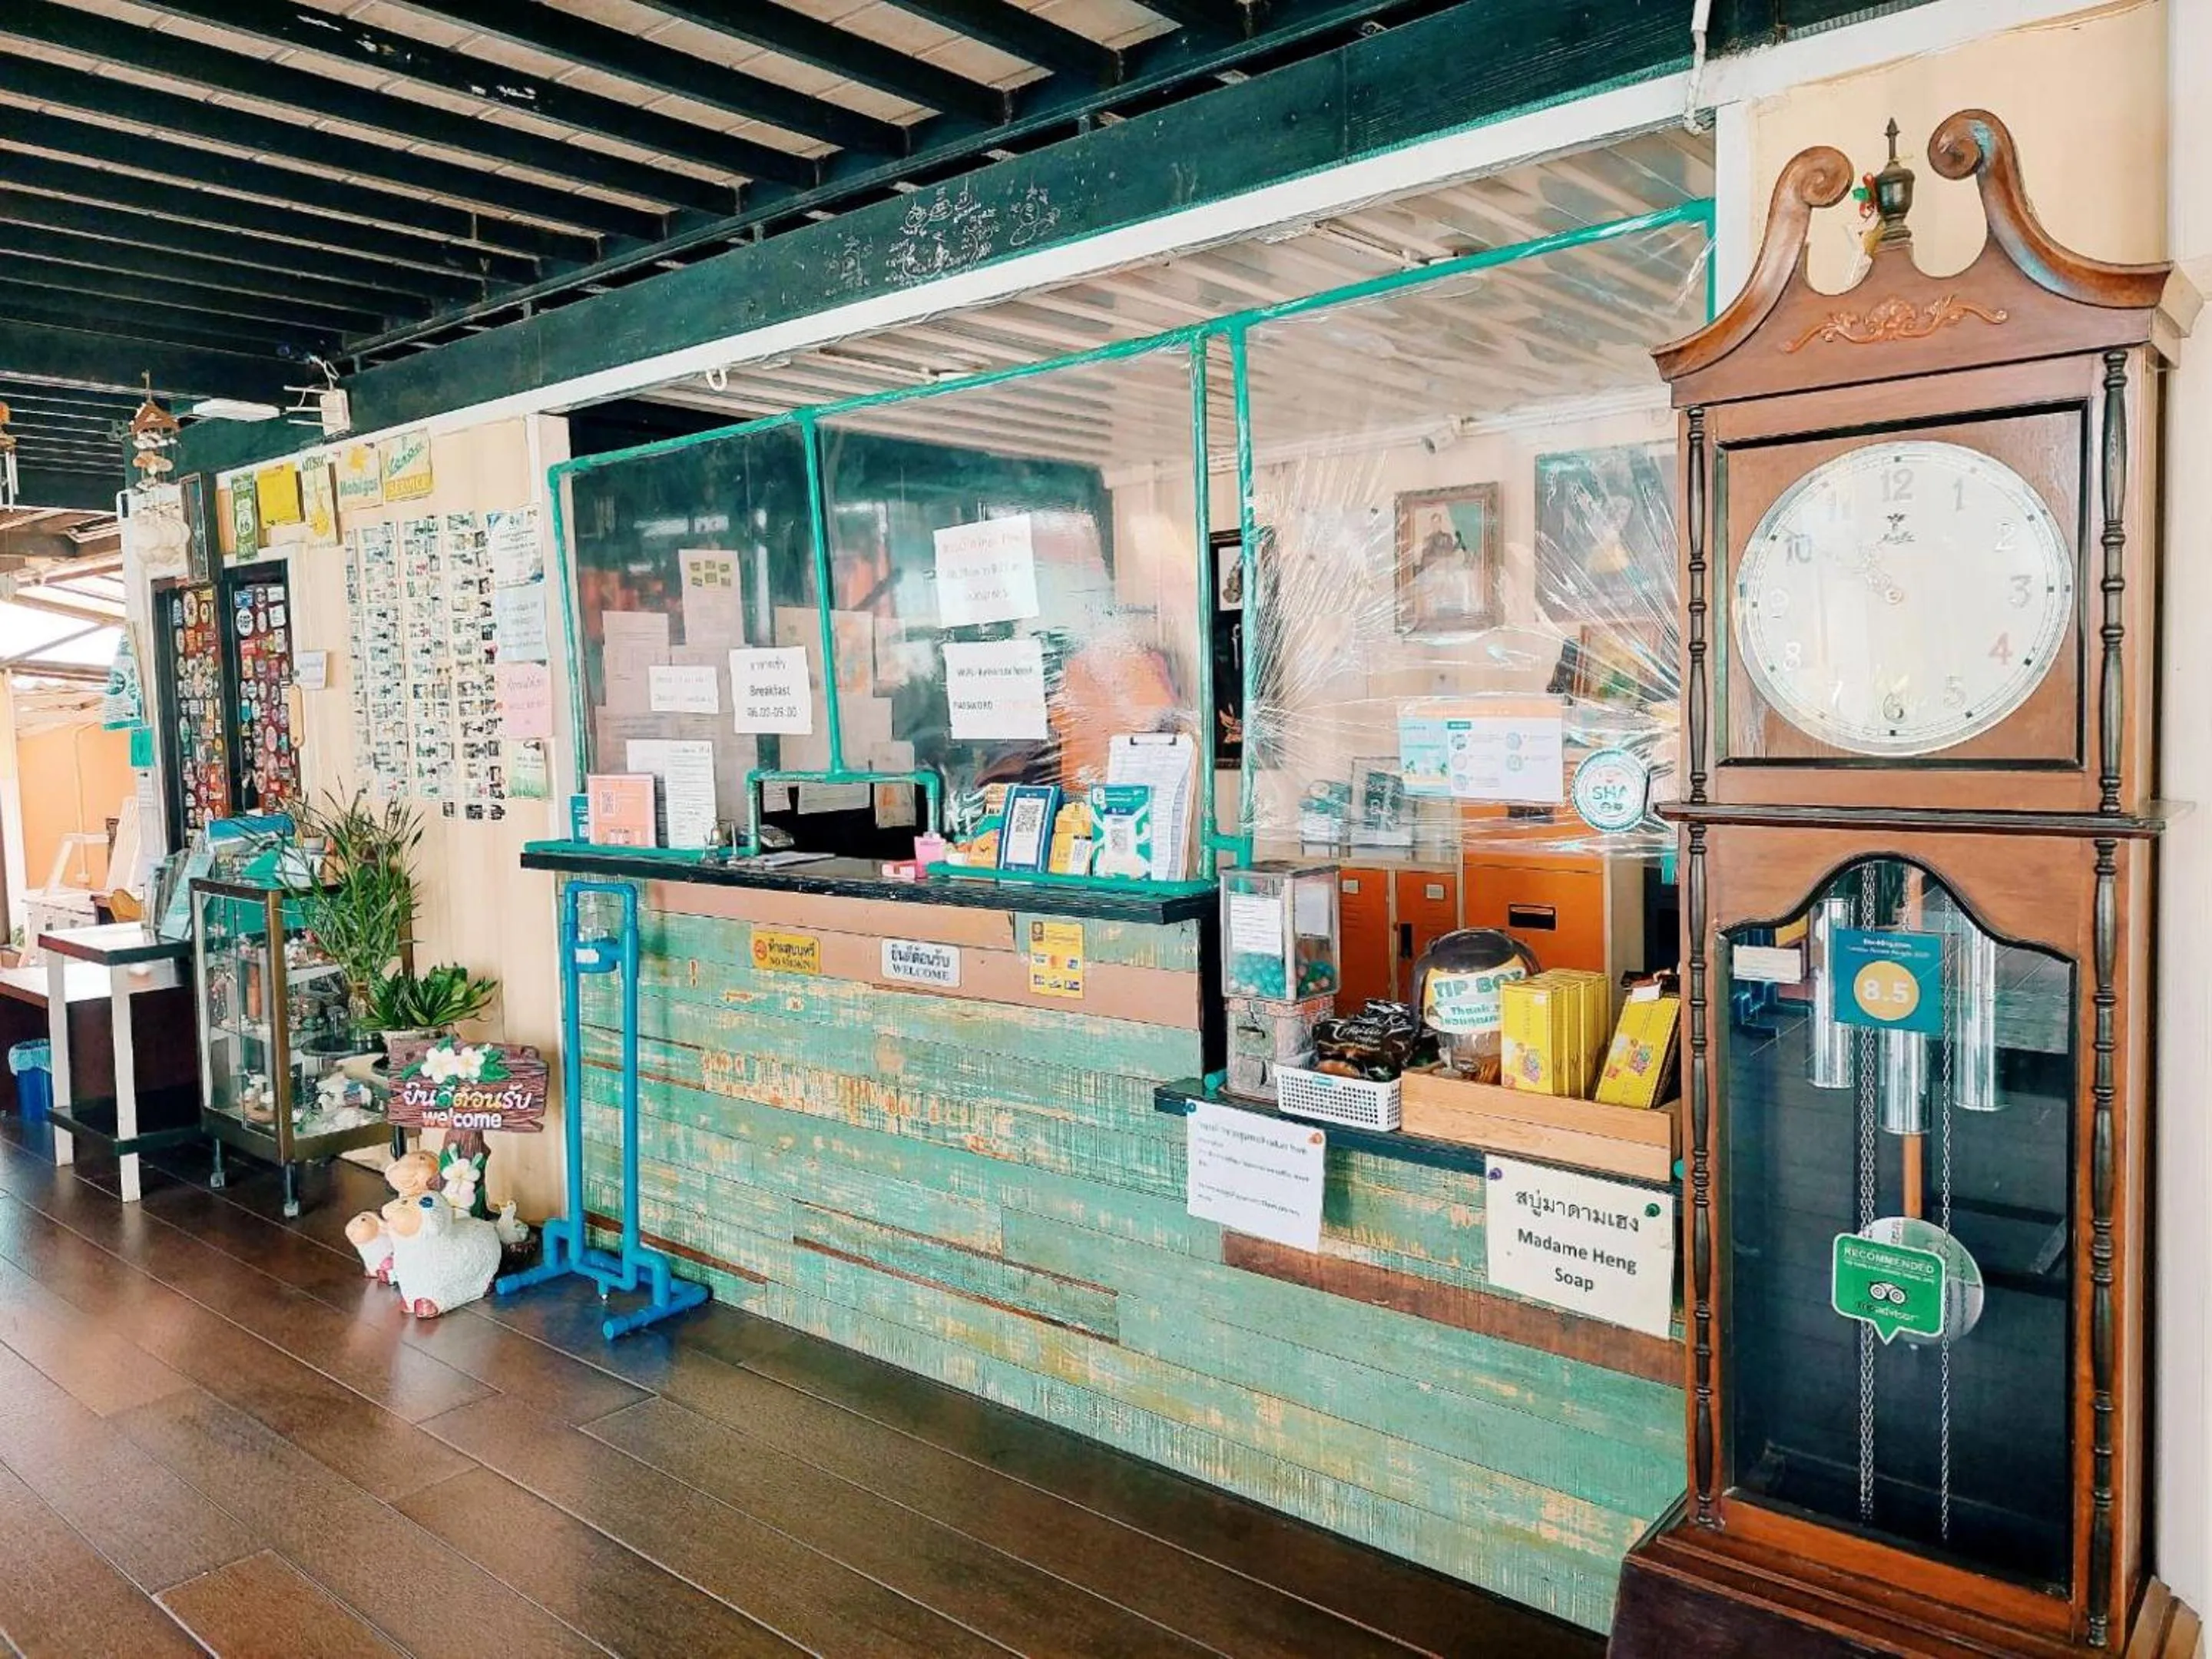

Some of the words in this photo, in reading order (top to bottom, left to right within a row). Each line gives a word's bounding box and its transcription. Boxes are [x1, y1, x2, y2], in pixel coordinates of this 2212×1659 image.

[1882, 469, 1914, 502] 12
[1954, 477, 1963, 512] 1
[1784, 535, 1813, 565] 10
[1995, 522, 2015, 552] 2
[1770, 588, 1790, 619] 9
[2010, 575, 2032, 609] 3
[1783, 641, 1802, 671] 8
[1988, 631, 2013, 666] 4
[750, 684, 791, 697] Breakfast
[1829, 680, 1844, 708] 7
[1943, 676, 1966, 709] 5
[1592, 784, 1628, 800] SHA
[892, 963, 950, 981] WELCOME
[1434, 980, 1469, 998] TIP
[1863, 979, 1909, 1004] 8.5
[402, 1081, 532, 1110] ยินดีต้อนรับ
[422, 1108, 502, 1129] welcome
[1515, 1190, 1640, 1233] สบู่มาดามเฮง
[1517, 1228, 1588, 1260] Madame
[1592, 1247, 1637, 1275] Heng
[1843, 1246, 1935, 1274] RECOMMENDED
[1555, 1267, 1594, 1292] Soap
